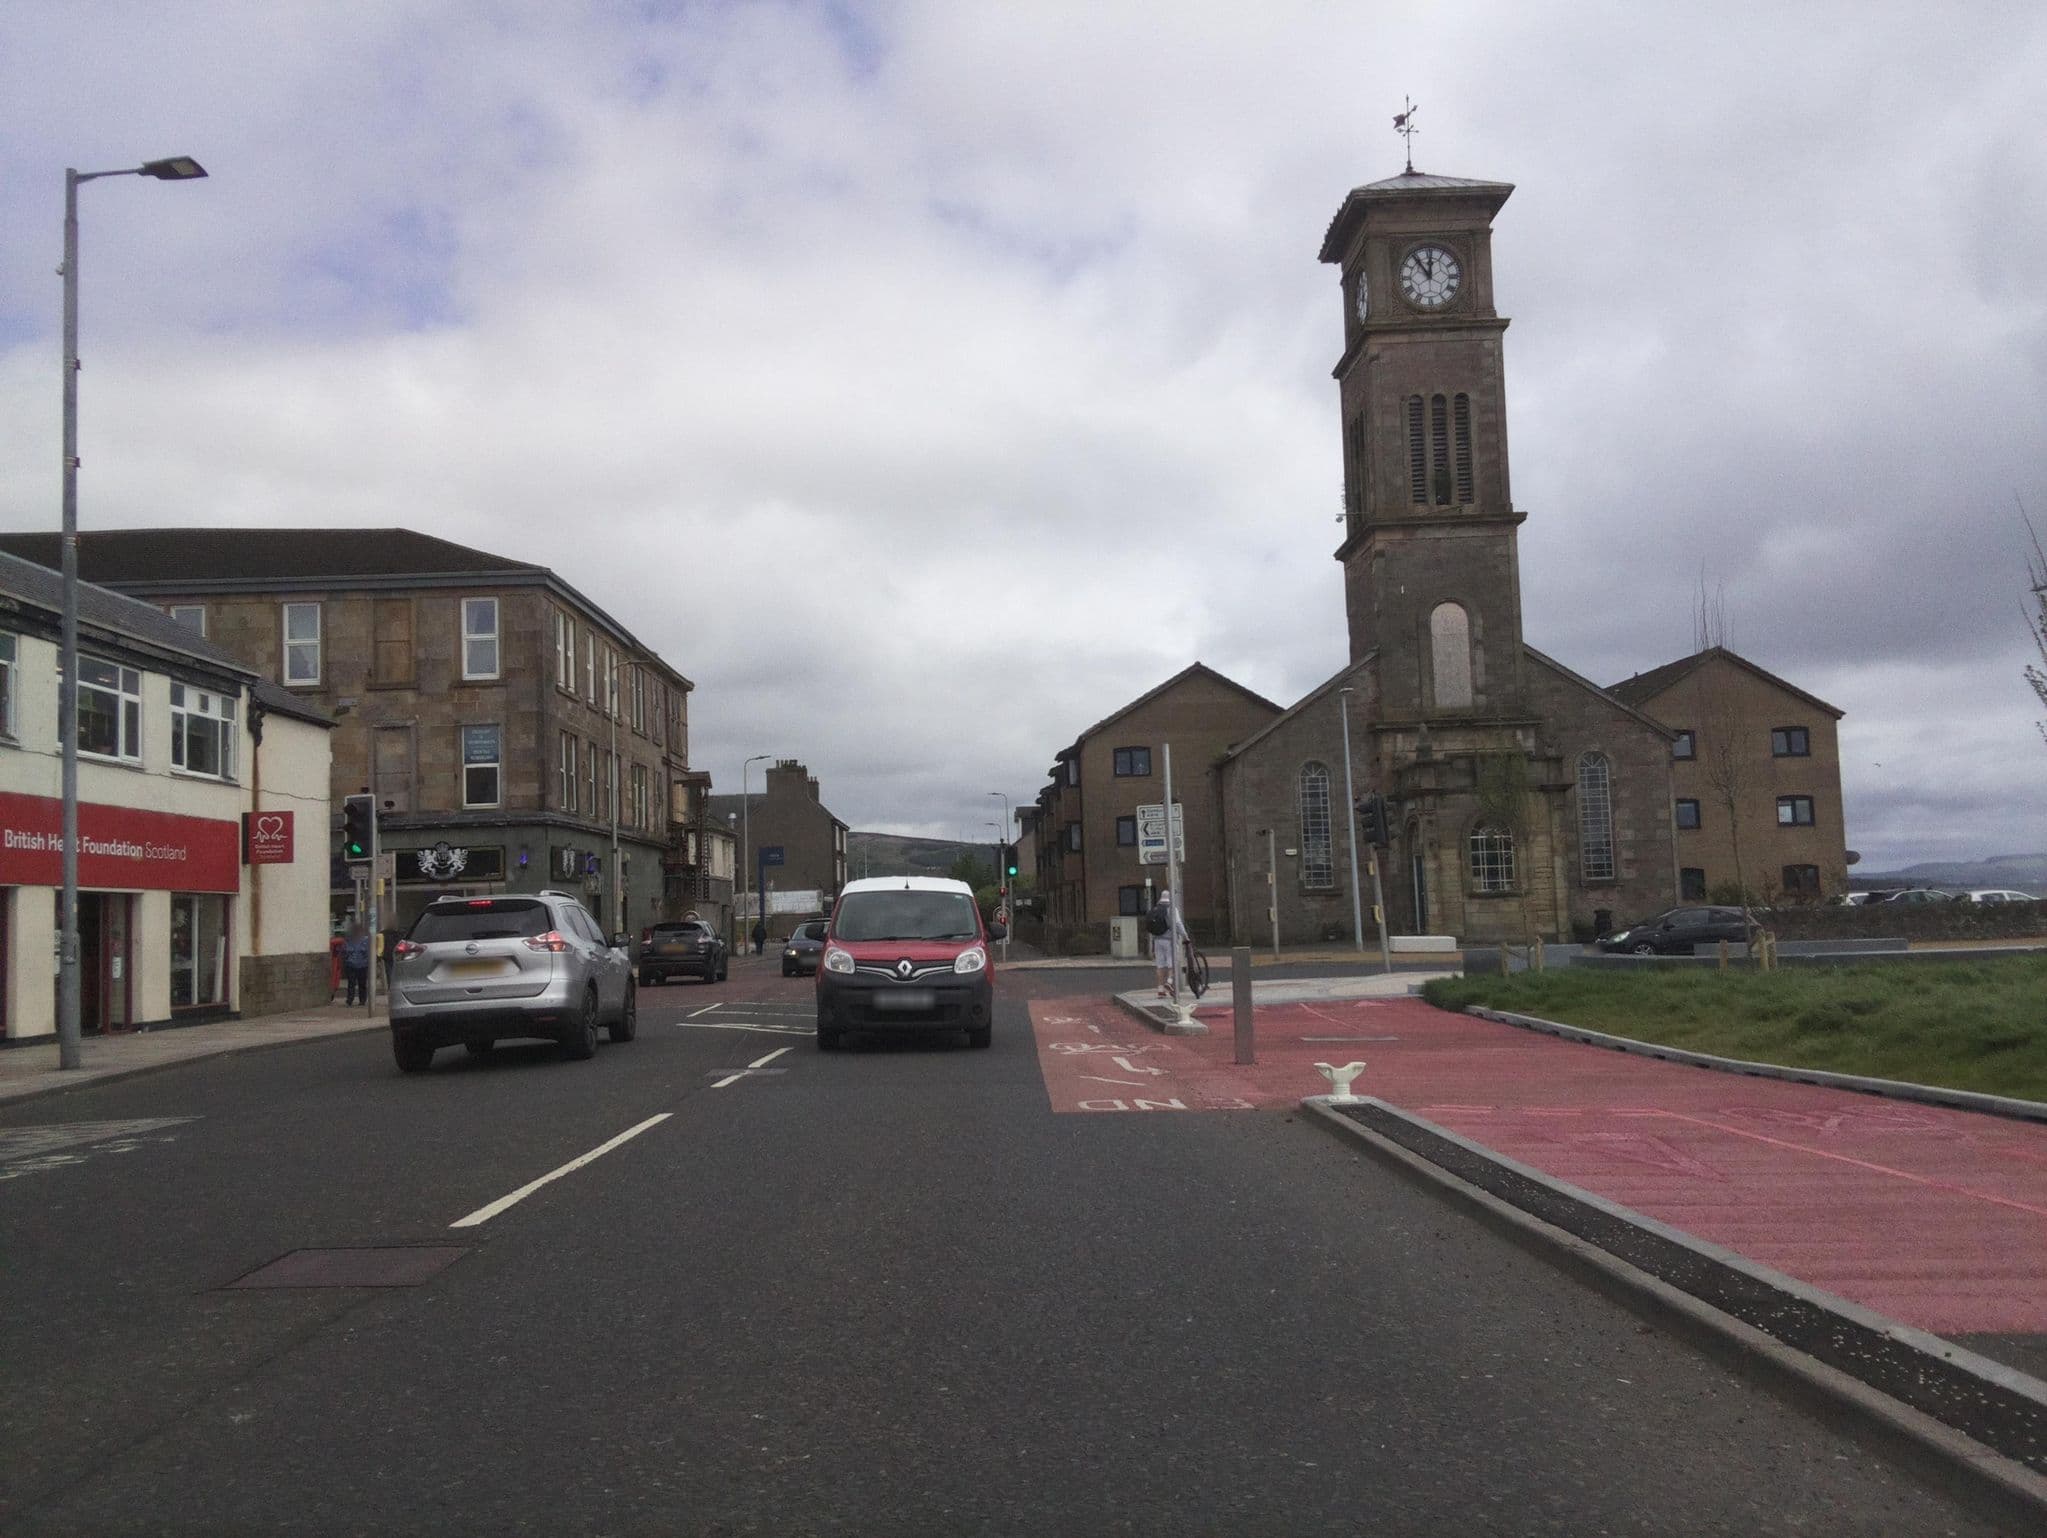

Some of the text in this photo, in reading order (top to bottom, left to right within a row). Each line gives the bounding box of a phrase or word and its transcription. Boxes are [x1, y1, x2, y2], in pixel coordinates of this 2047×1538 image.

[5, 829, 186, 861] British Het Foundation Scotland
